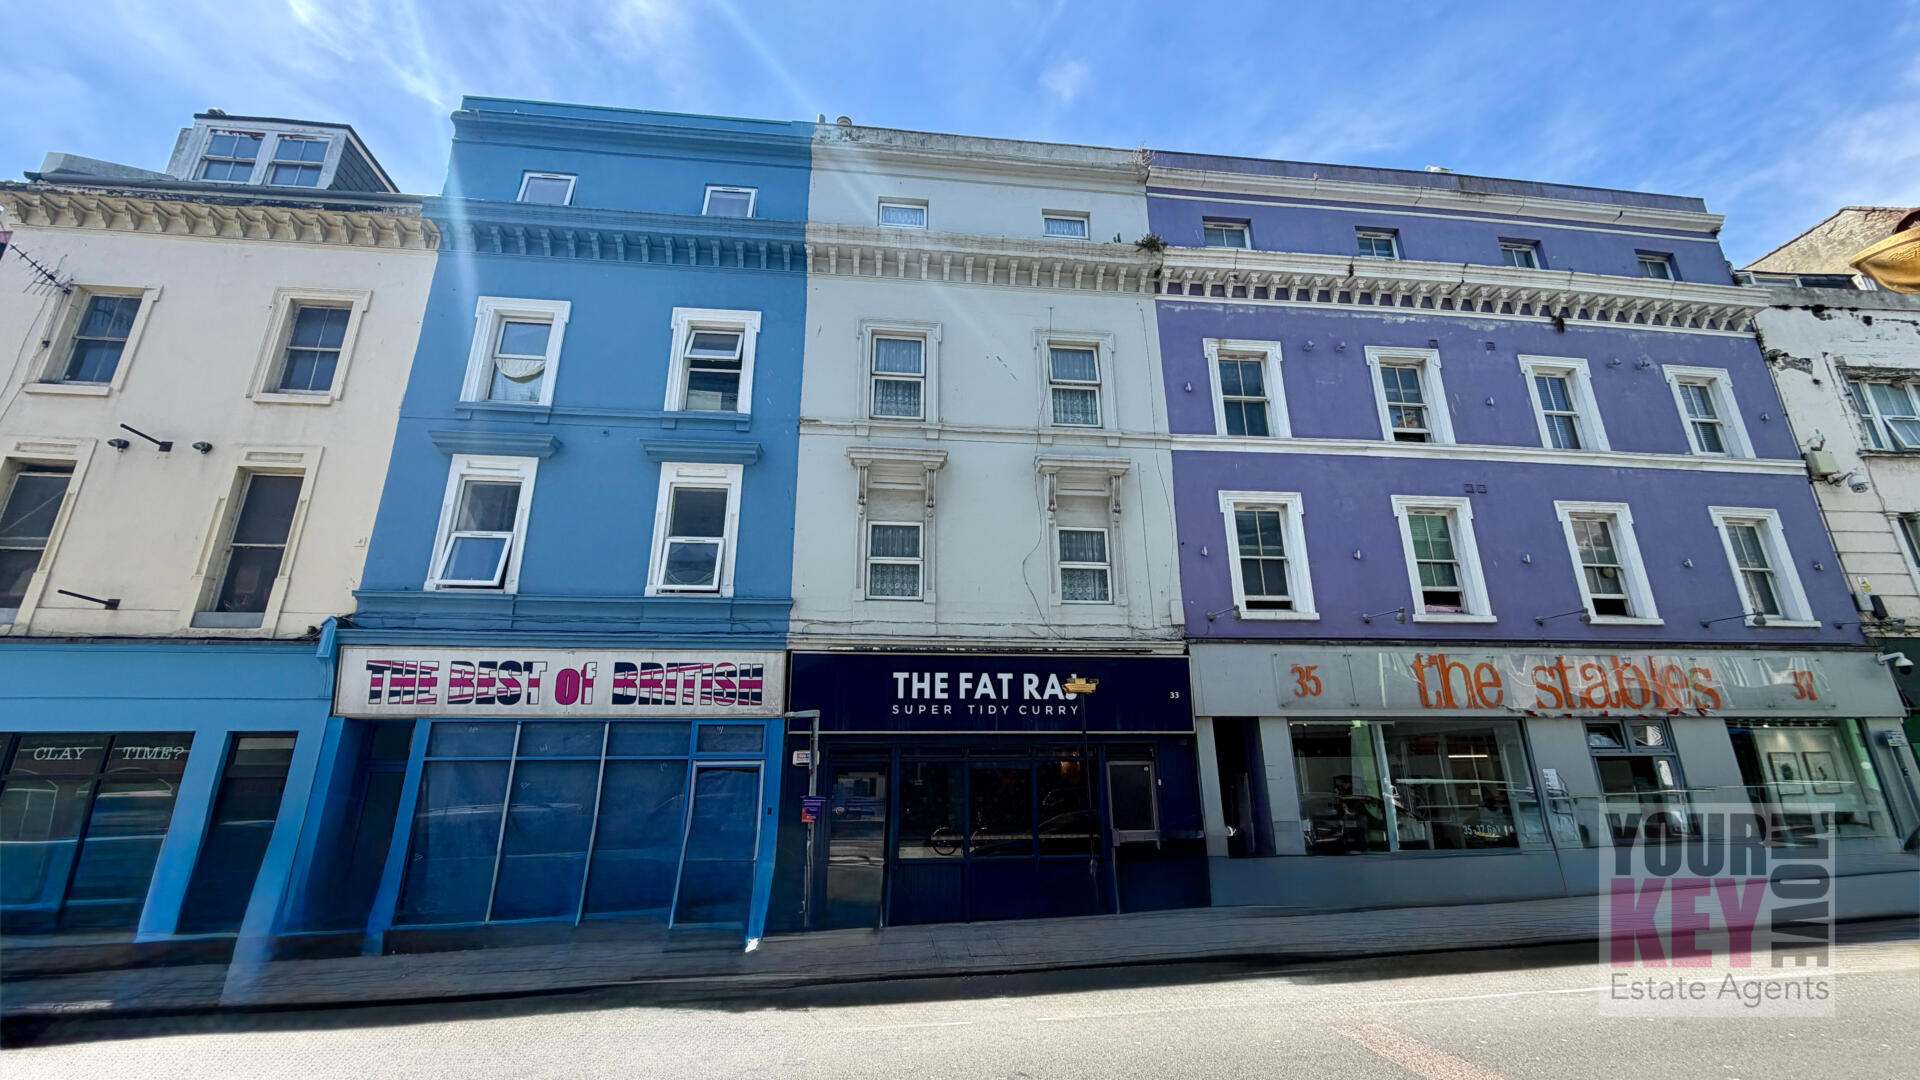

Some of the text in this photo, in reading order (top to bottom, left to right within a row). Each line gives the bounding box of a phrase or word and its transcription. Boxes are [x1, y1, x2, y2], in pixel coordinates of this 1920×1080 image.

[366, 660, 440, 705] THE
[447, 660, 548, 706] BEST
[612, 661, 764, 706] BRITISH
[893, 672, 949, 699] THE
[959, 672, 1014, 700] FAT
[1169, 691, 1180, 699] 33
[1291, 664, 1322, 698] 35
[1411, 653, 1720, 709] the stables
[892, 704, 1079, 716] SUPER TIDY CURRY
[33, 746, 186, 761] CLAY TIME?
